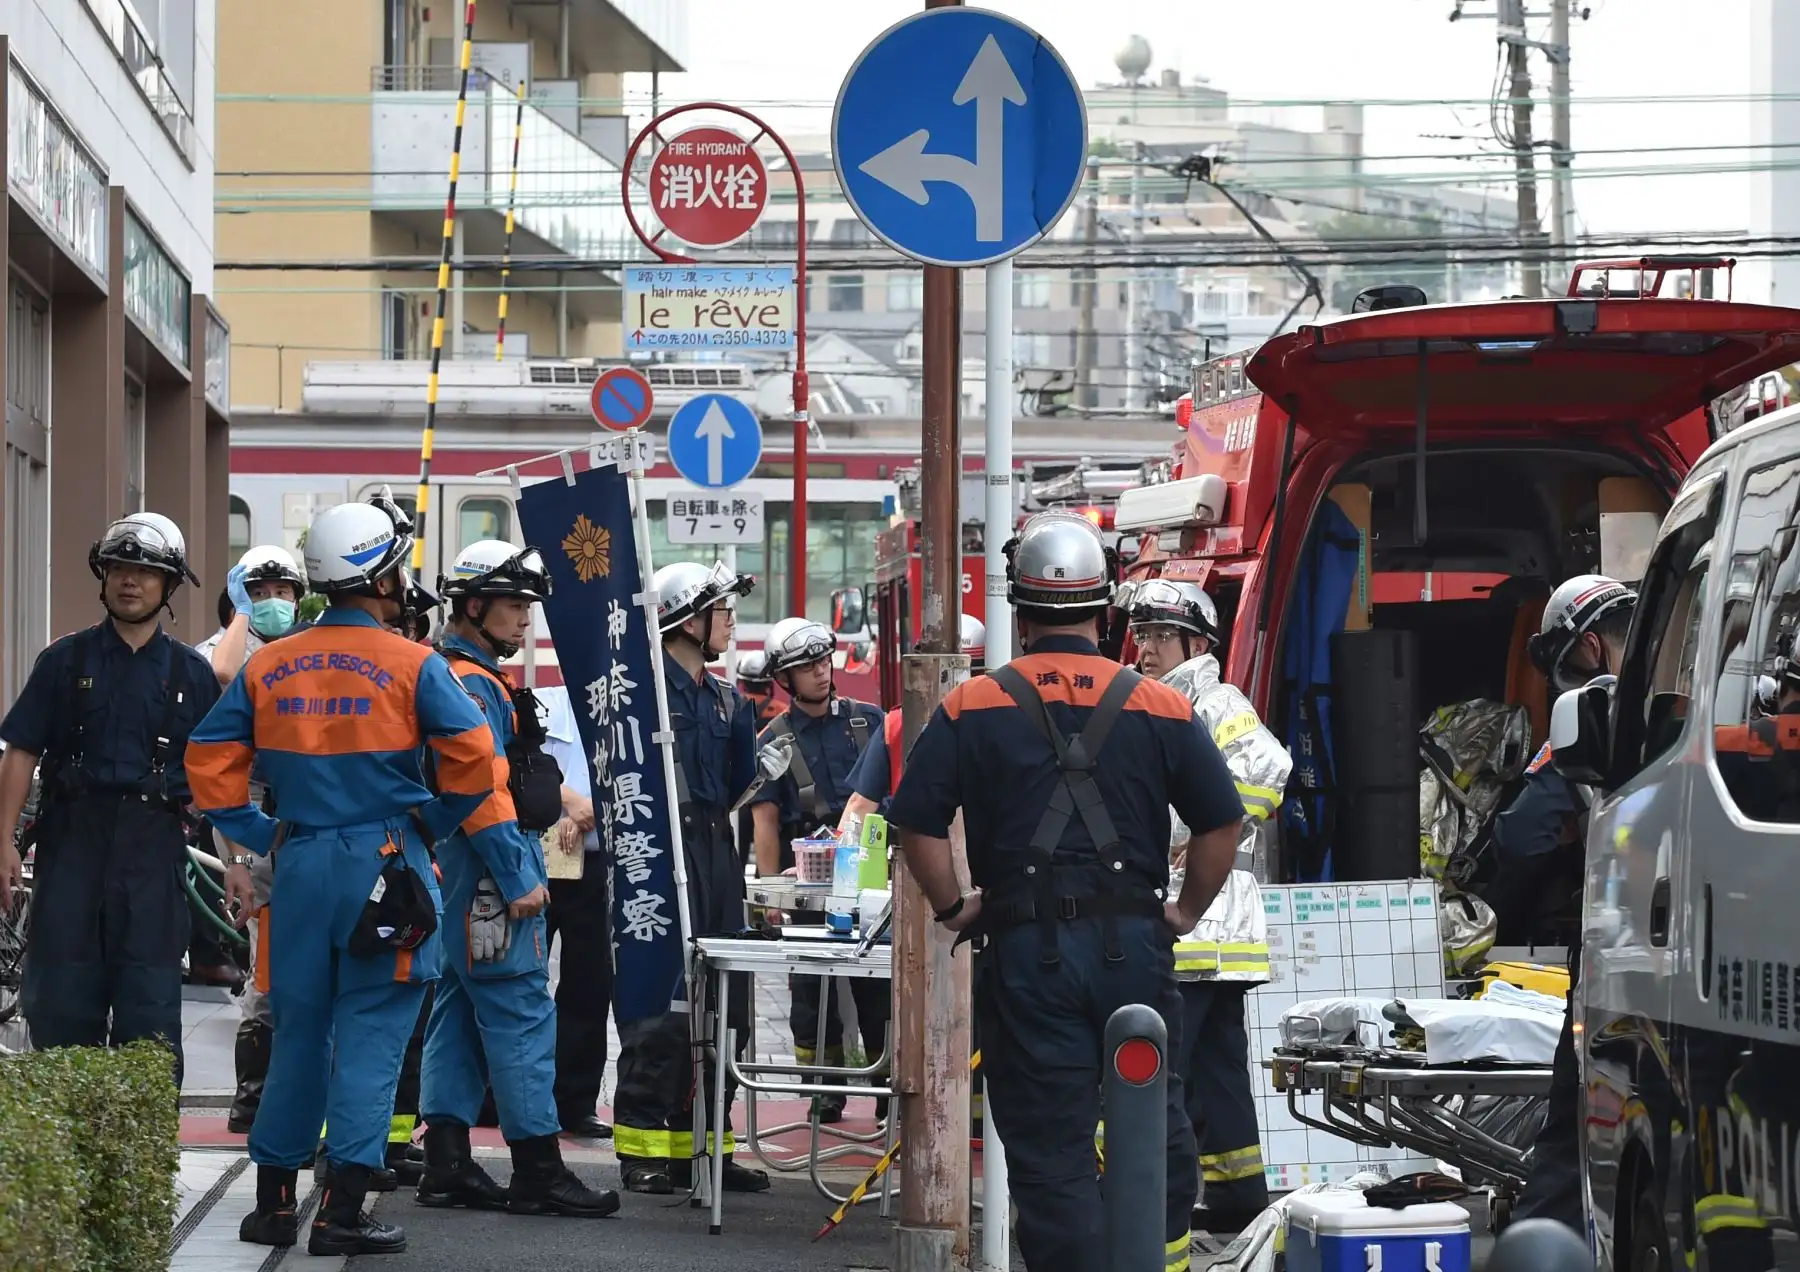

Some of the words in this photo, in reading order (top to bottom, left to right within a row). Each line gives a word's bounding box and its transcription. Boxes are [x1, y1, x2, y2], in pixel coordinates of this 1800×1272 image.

[668, 143, 693, 156] FIRE
[697, 143, 747, 156] HYDRANT
[660, 164, 759, 209] 消火栓
[652, 284, 674, 298] hair
[676, 285, 708, 298] make
[639, 293, 670, 329] le
[694, 299, 780, 328] rêve
[725, 330, 788, 345] 350-4373
[673, 500, 758, 517] 自転車を除く
[1054, 567, 1065, 578] 西
[261, 653, 324, 690] POLICE
[328, 653, 395, 690] RESCUE
[607, 598, 672, 941] 神奈川県警察
